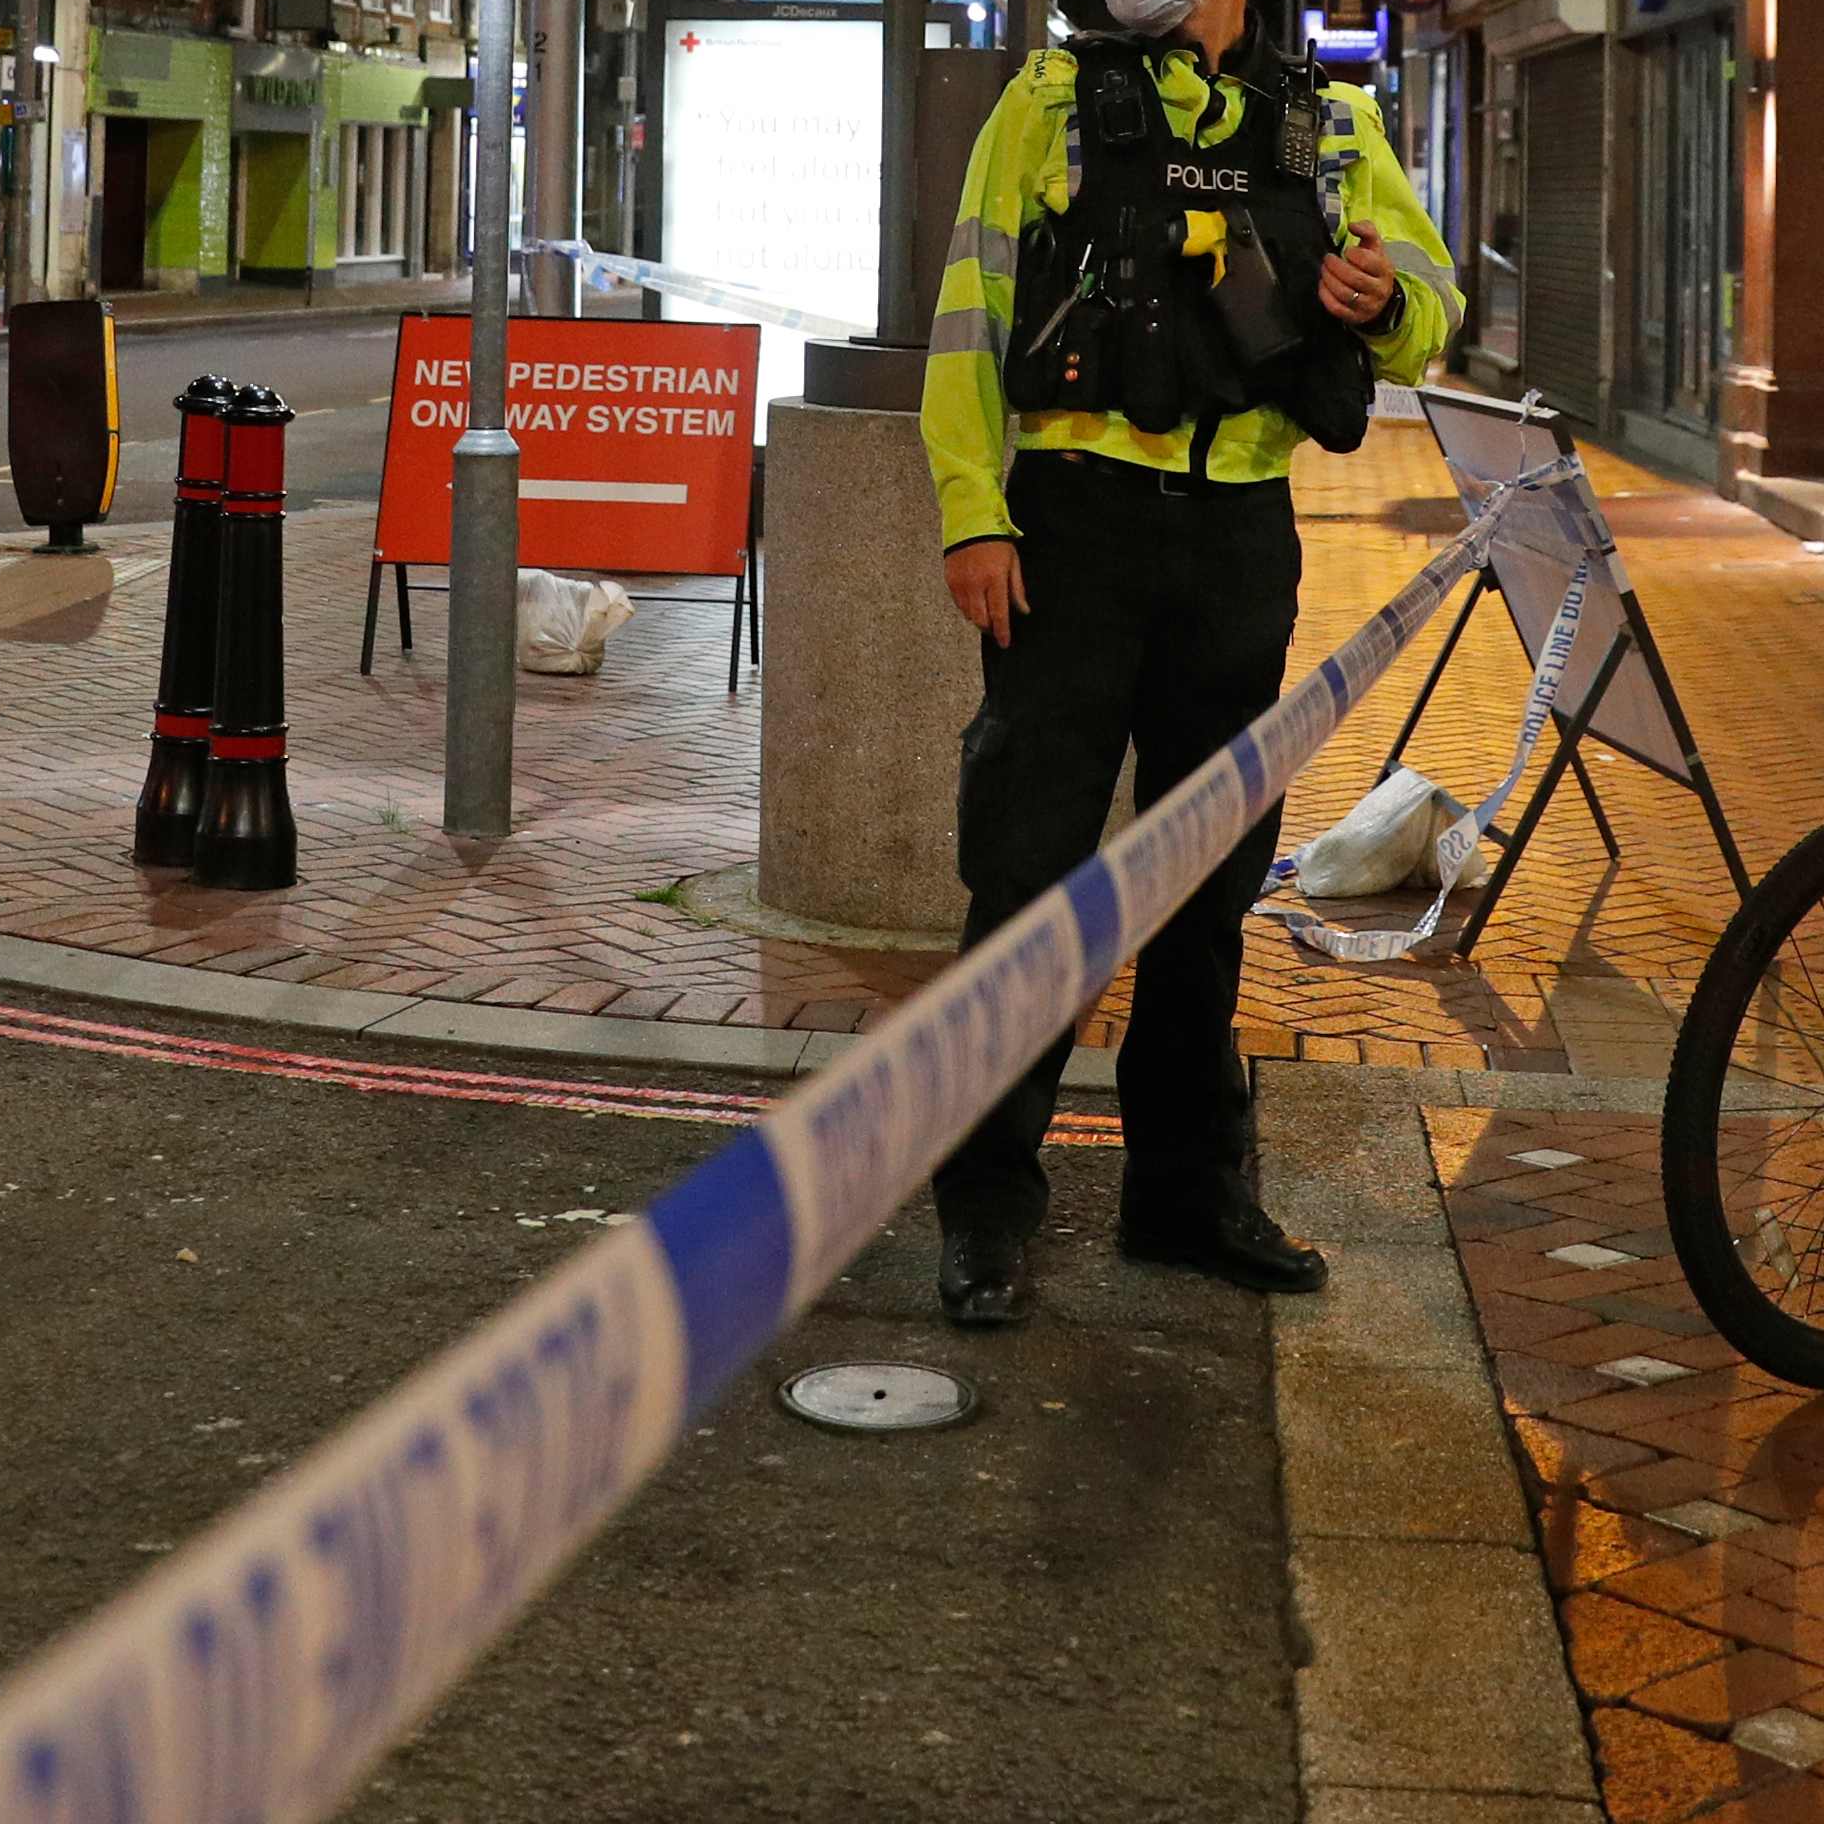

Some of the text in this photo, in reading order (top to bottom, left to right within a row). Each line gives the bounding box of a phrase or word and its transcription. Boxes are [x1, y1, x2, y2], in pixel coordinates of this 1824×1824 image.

[1166, 163, 1249, 193] POLICE
[509, 362, 738, 396] PEDESTRIAN
[504, 404, 577, 432] WAY
[586, 406, 735, 437] SYSTEM
[1545, 625, 1576, 671] LINE
